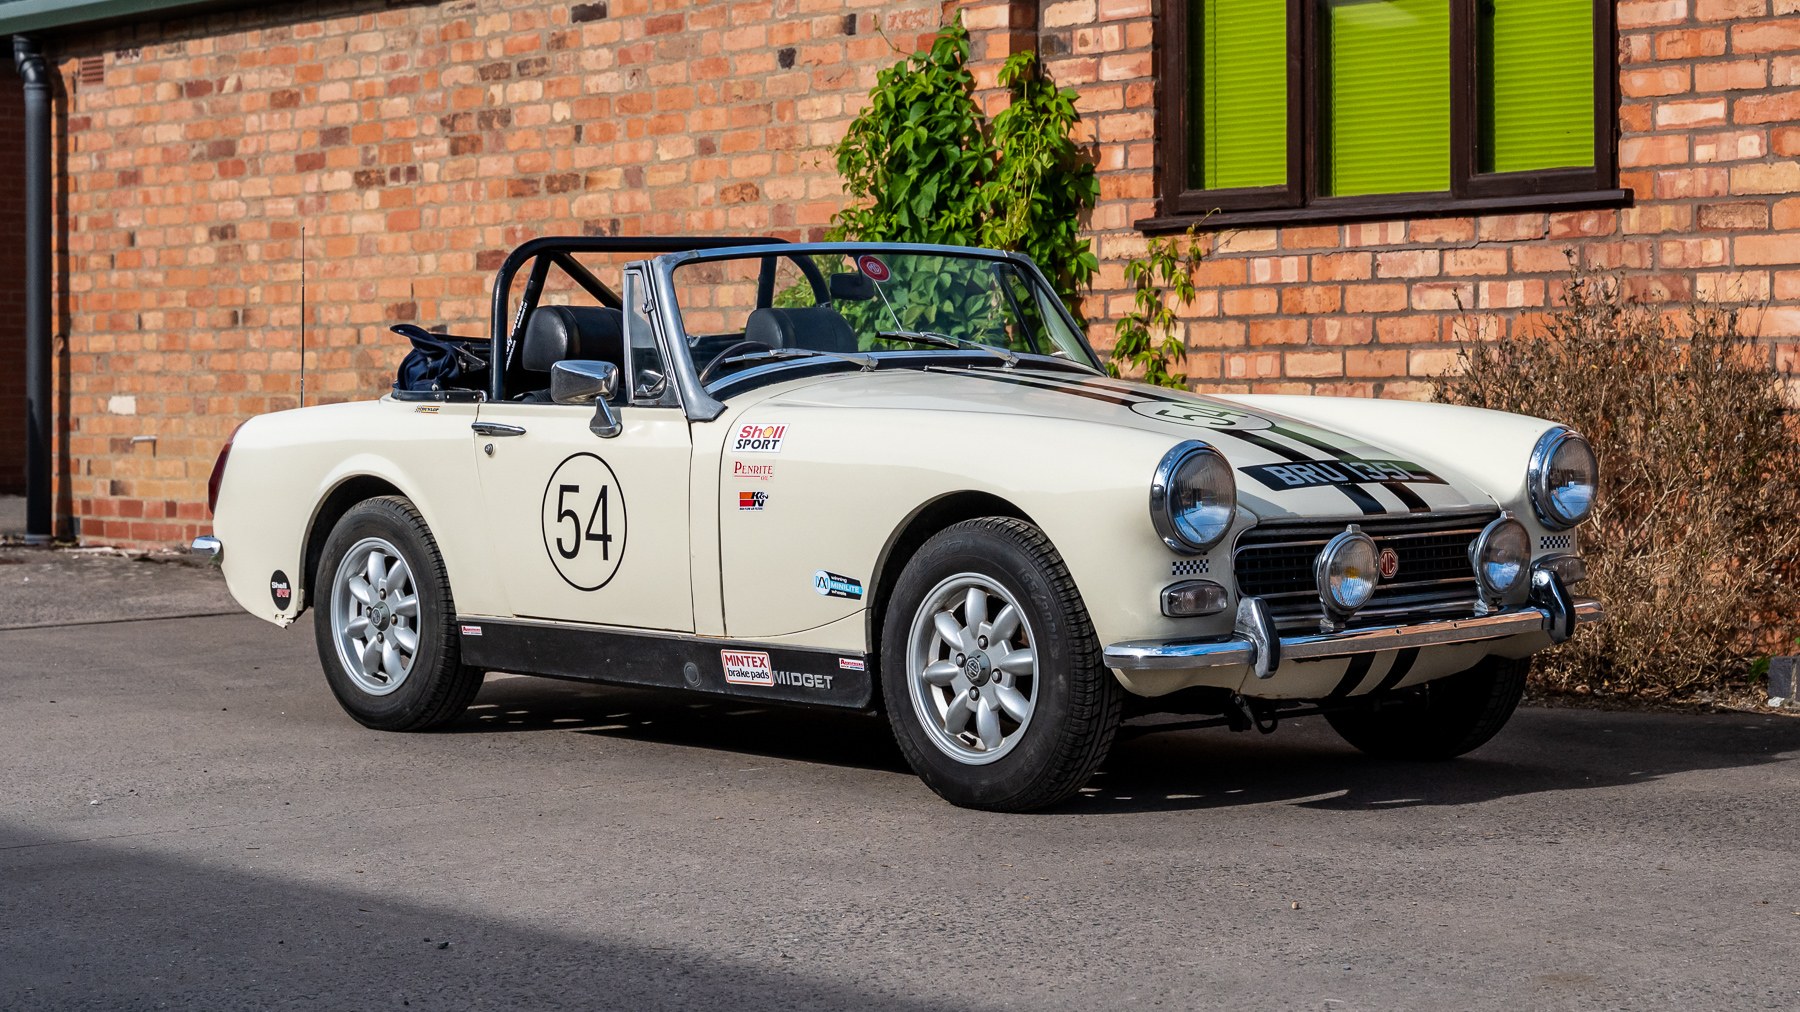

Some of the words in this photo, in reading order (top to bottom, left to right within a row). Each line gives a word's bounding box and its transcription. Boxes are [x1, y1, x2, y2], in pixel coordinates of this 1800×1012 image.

[1155, 403, 1248, 426] 54
[740, 425, 786, 439] Shll
[736, 439, 780, 450] SPORT
[1262, 463, 1349, 486] BRU
[1338, 461, 1428, 481] 135L
[556, 484, 612, 561] 54
[271, 581, 288, 589] Shell
[830, 580, 859, 594] MINILITE
[724, 654, 768, 669] MINTEX
[727, 667, 751, 679] brake
[751, 669, 770, 681] pads
[773, 670, 833, 690] MIDGET
